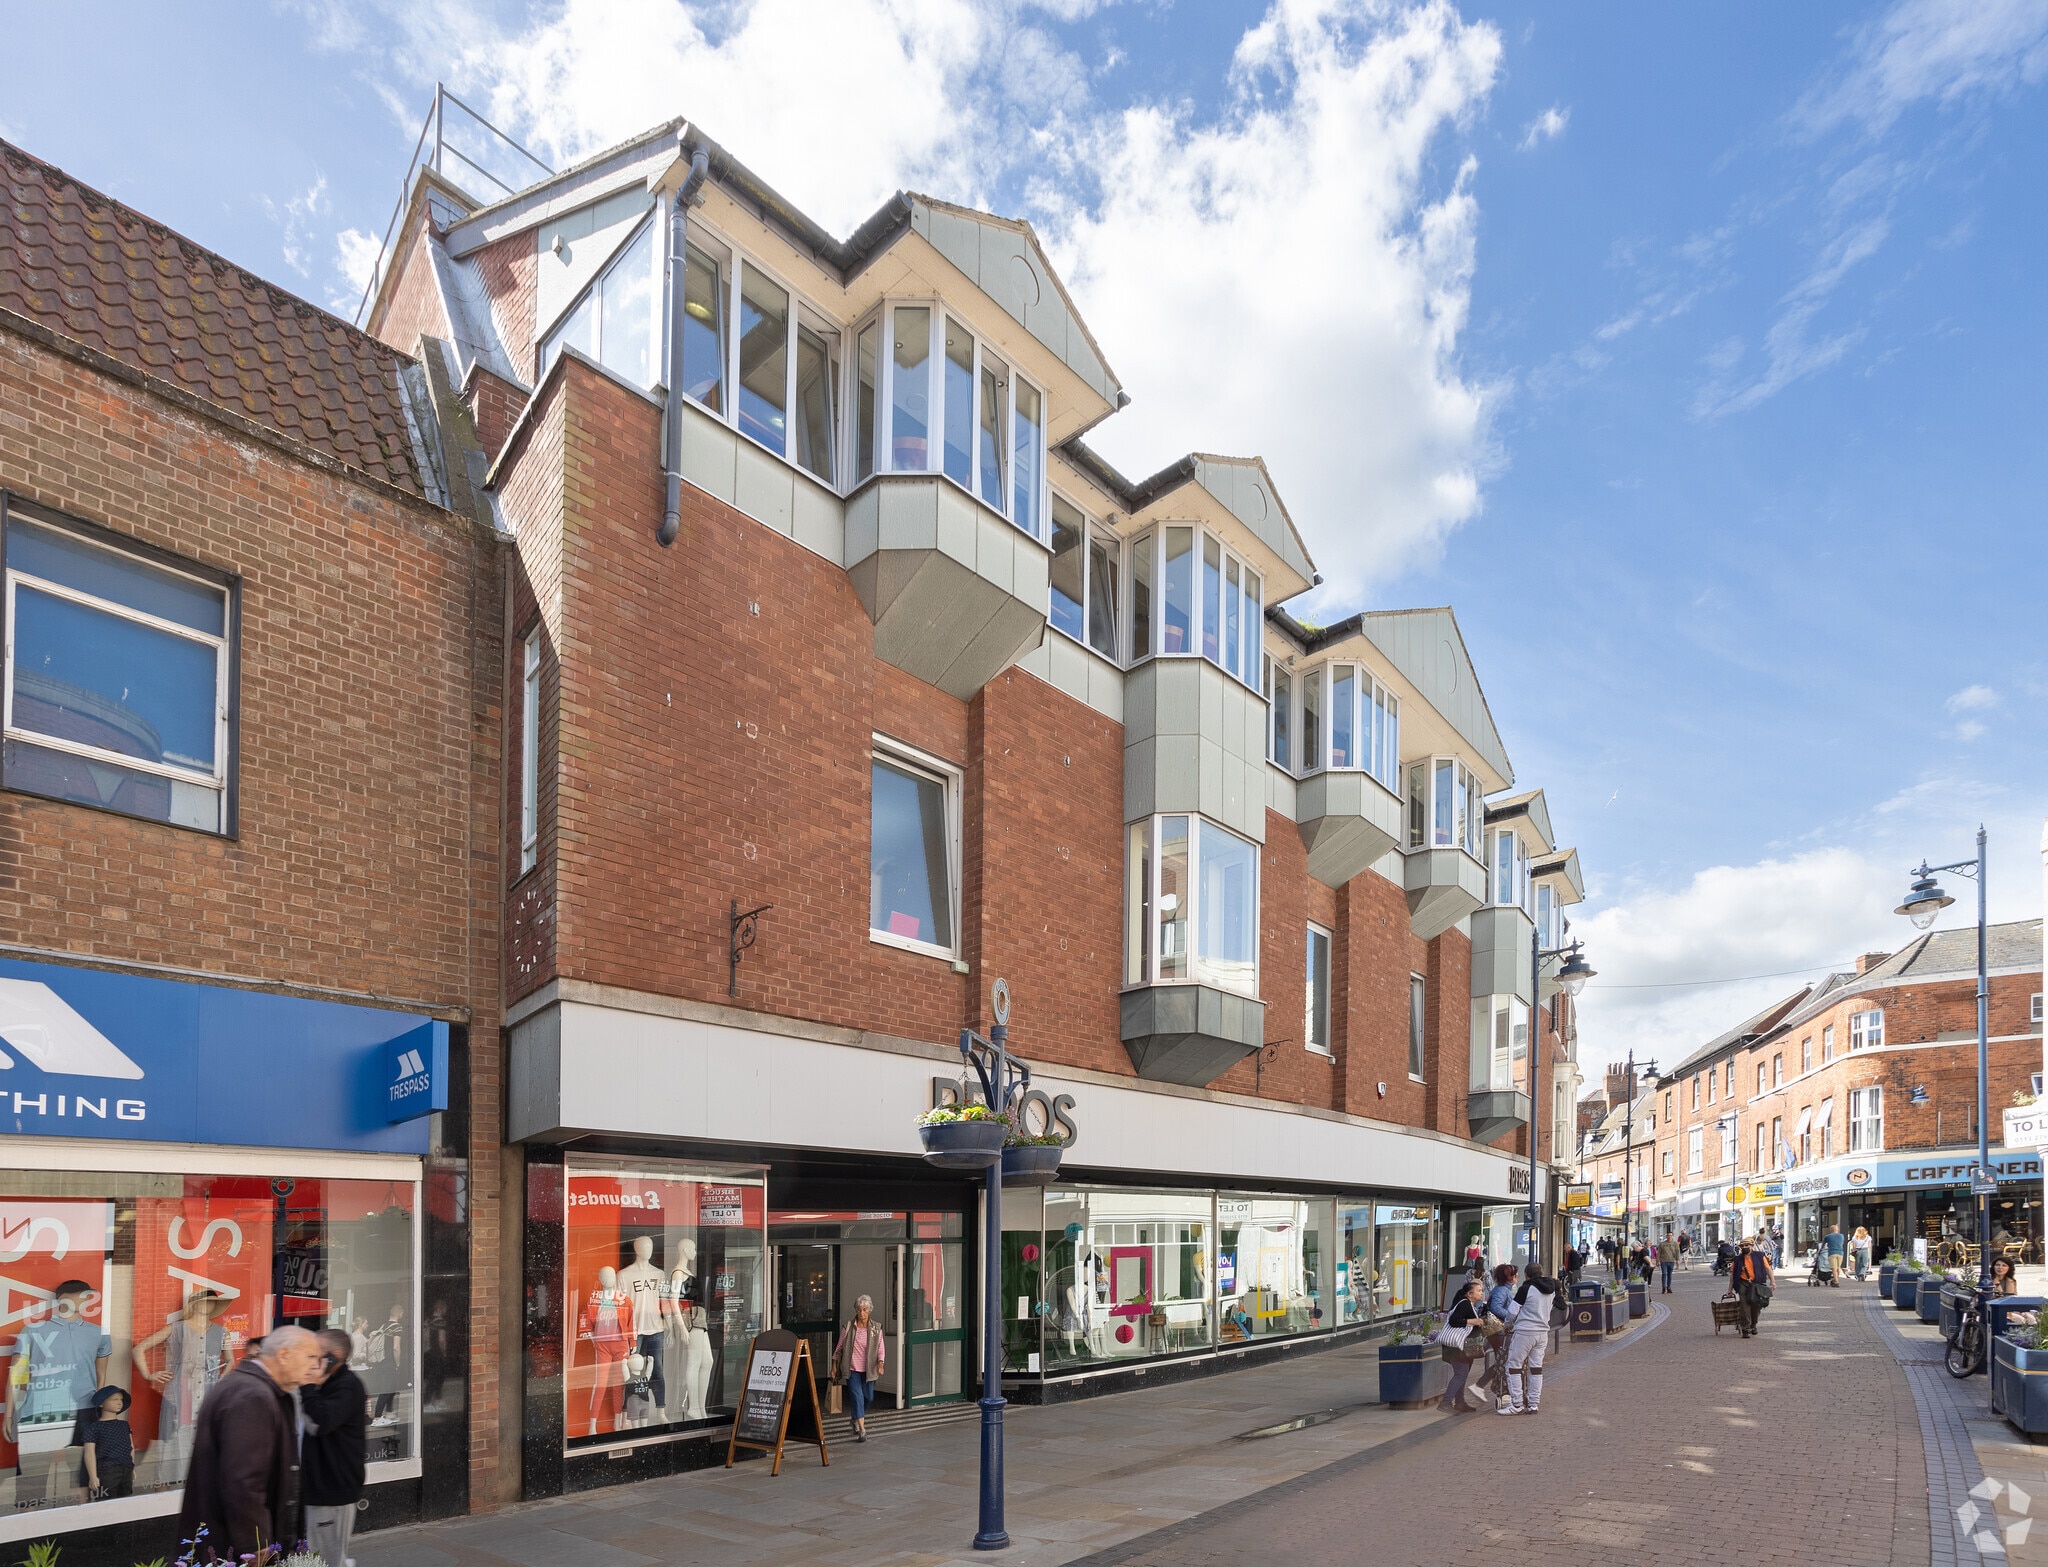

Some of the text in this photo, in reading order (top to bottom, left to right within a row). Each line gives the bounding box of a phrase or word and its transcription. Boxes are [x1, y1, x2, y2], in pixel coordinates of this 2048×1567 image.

[389, 1073, 430, 1102] TRESPASS
[2012, 1121, 2033, 1133] TO
[760, 1366, 782, 1376] REBOS
